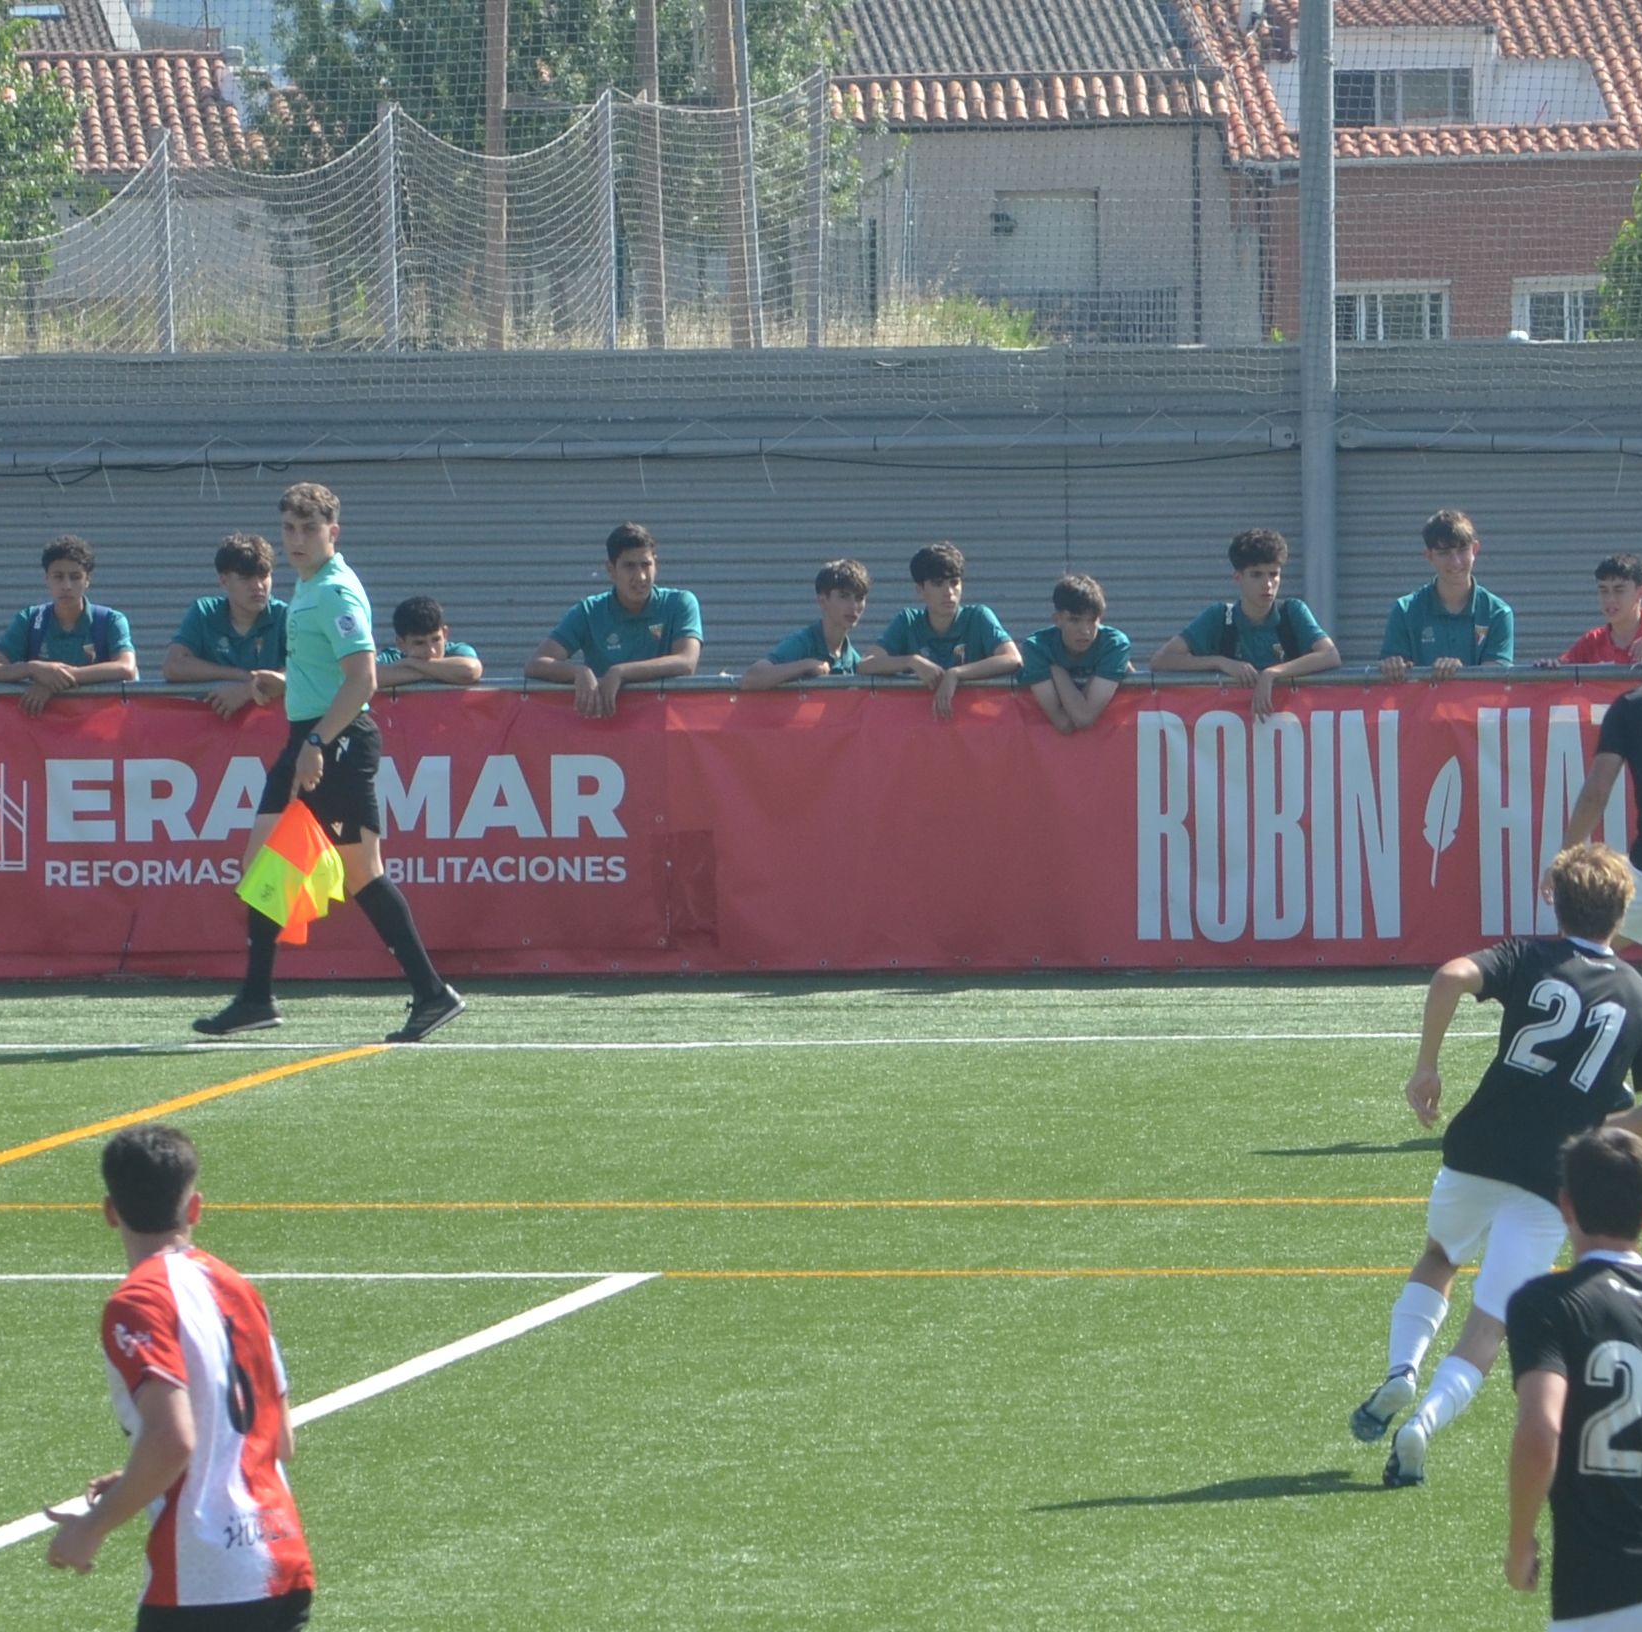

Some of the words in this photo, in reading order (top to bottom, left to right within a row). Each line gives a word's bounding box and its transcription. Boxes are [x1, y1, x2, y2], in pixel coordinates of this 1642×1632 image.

[45, 755, 629, 843] ERAMAR
[1136, 709, 1401, 942] ROBIN
[44, 857, 242, 887] REFORMAS
[384, 855, 627, 884] BILITACIONES
[1503, 978, 1627, 1094] 21
